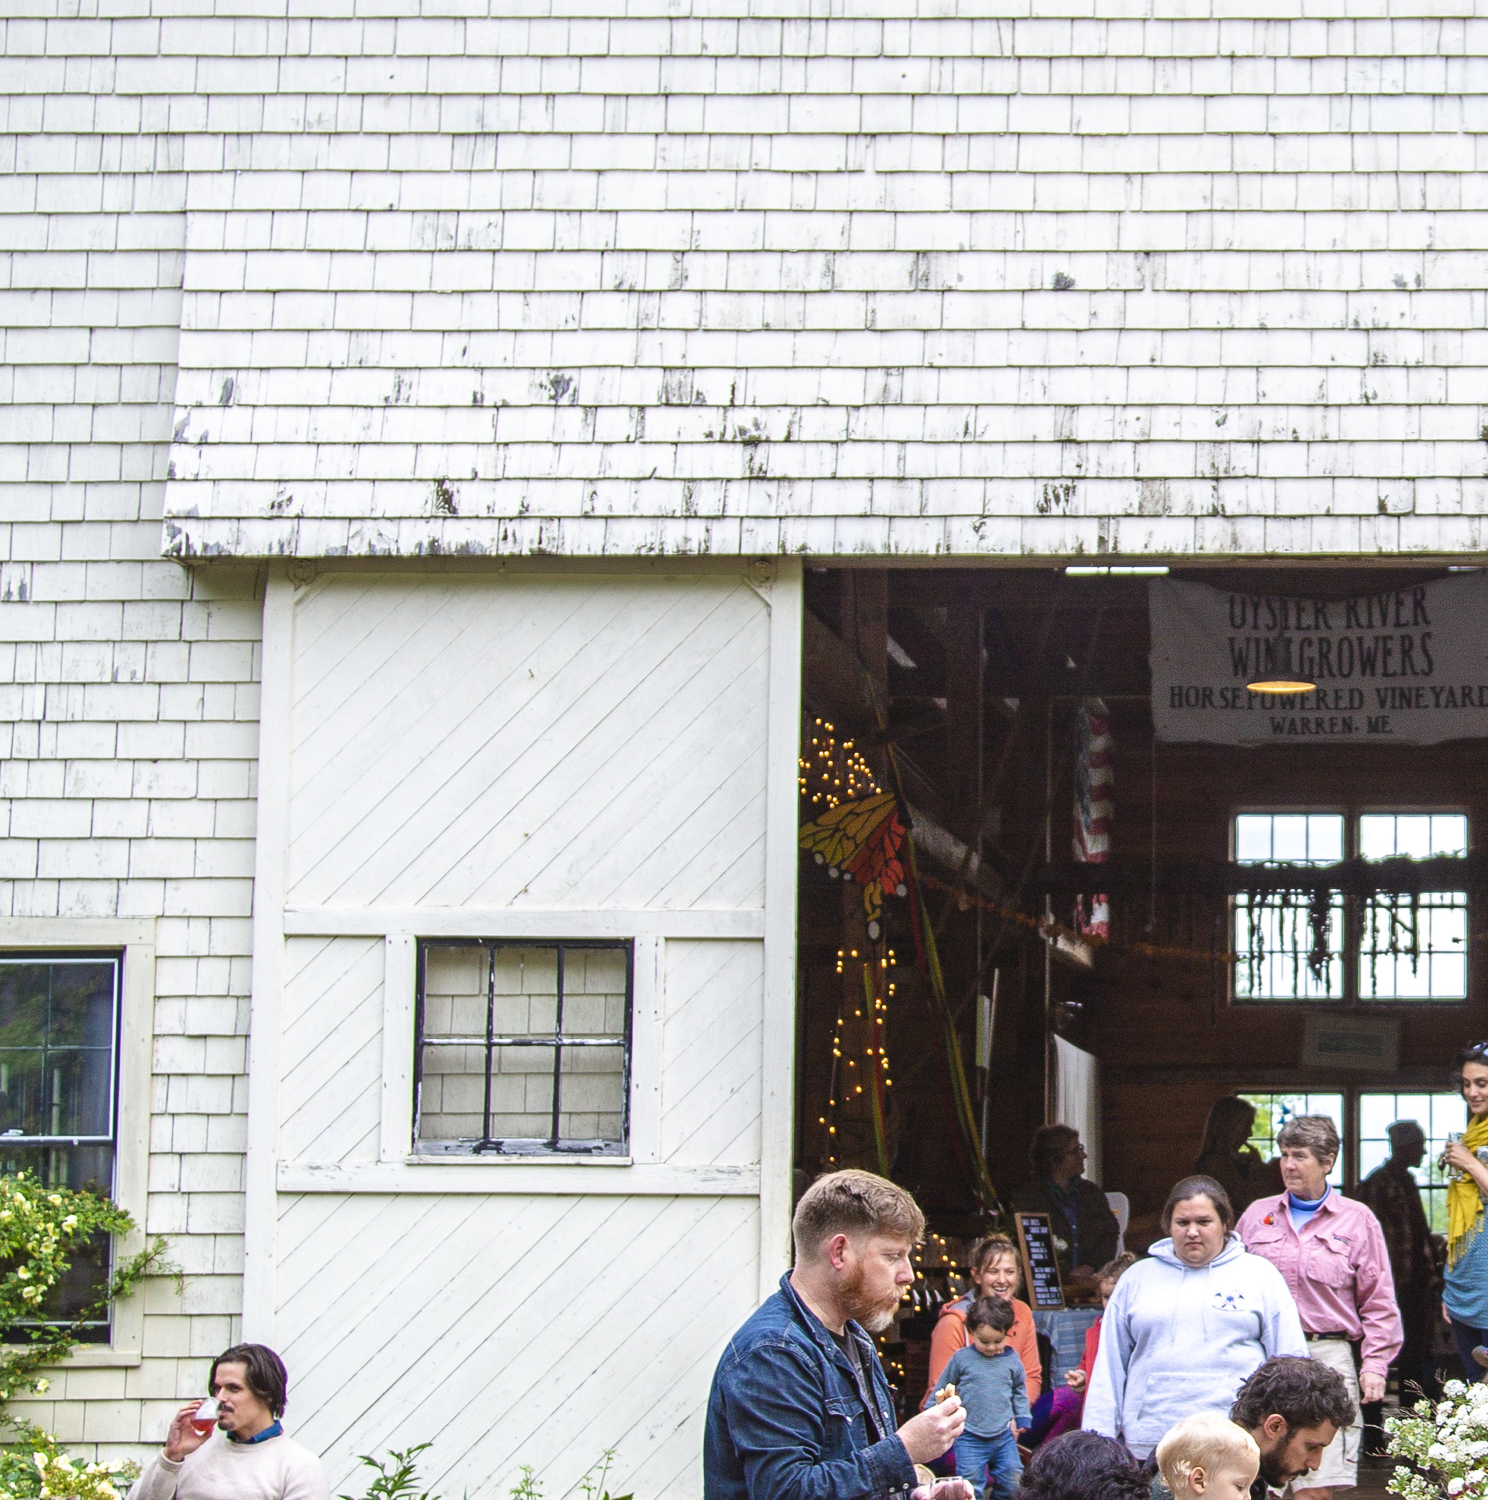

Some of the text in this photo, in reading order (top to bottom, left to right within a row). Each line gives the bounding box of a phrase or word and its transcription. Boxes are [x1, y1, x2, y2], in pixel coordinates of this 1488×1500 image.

[1345, 587, 1431, 629] RIVER
[1169, 685, 1364, 711] HORSEPOWERED
[1366, 715, 1392, 734] ME
